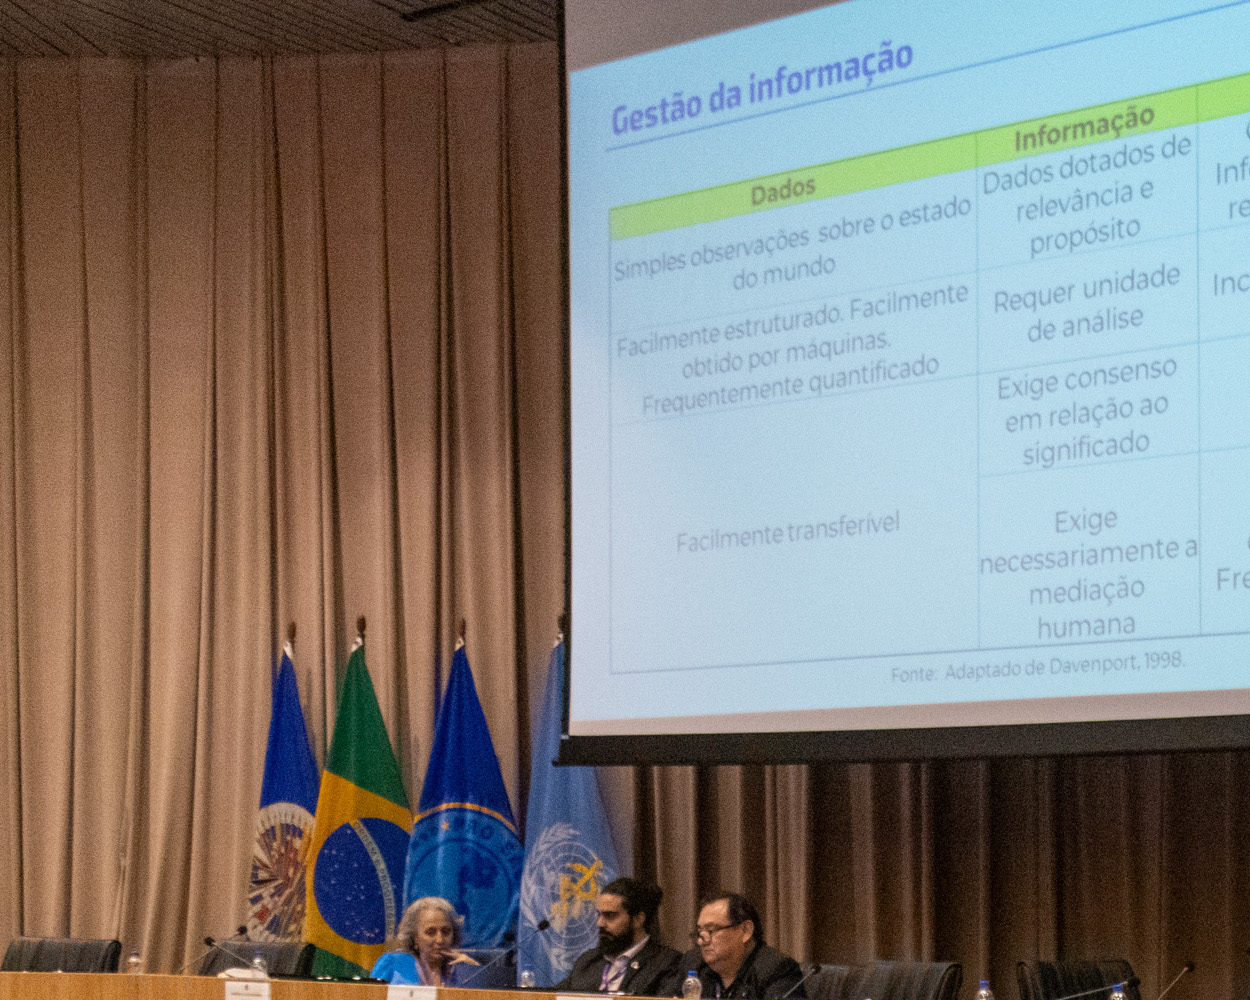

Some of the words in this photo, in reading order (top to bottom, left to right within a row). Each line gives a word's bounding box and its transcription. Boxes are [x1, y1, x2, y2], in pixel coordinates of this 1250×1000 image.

[611, 91, 701, 135] Gestão
[709, 82, 741, 113] da
[749, 40, 913, 104] informação
[1015, 104, 1155, 153] Informação
[983, 168, 1054, 195] Dados
[1059, 139, 1155, 178] dotados
[1162, 134, 1192, 158] de
[751, 176, 815, 206] Dados
[1016, 181, 1134, 222] relevância
[1140, 180, 1154, 200] e
[614, 248, 686, 282] Simples
[691, 229, 810, 267] observações
[818, 213, 874, 244] sobre
[880, 213, 894, 232] o
[899, 197, 971, 228] estado
[1030, 217, 1141, 259] propósito
[733, 267, 758, 291] do
[764, 255, 835, 283] mundo
[994, 281, 1075, 313] Requer
[1083, 262, 1181, 299] unidade
[618, 324, 720, 358] Facilmente
[724, 305, 844, 342] estruturado.
[850, 282, 968, 320] Facilmente
[1027, 316, 1056, 344] de
[1062, 305, 1144, 338] análise
[682, 352, 742, 380] obtido
[748, 350, 778, 372] por
[786, 327, 890, 367] máquinas.
[643, 377, 802, 417] Frequentemente
[809, 355, 939, 394] quantificado
[998, 366, 1059, 400] Exige
[1065, 356, 1177, 389] consenso
[1005, 410, 1041, 433] em
[1049, 394, 1134, 428] relação
[1140, 394, 1169, 418] ao
[1022, 429, 1150, 467] significado
[677, 526, 783, 553] Facilmente
[787, 510, 900, 541] transferível
[1055, 507, 1118, 534] Exige
[979, 538, 1180, 574] necessariamente
[1185, 540, 1198, 557] a
[1029, 575, 1146, 606] mediação
[1037, 613, 1136, 640] humana
[891, 666, 937, 684] Fonte:
[945, 661, 1021, 682] Adaptado
[1025, 659, 1044, 675] de
[1049, 652, 1139, 675] Davenport,
[1145, 650, 1185, 670] 1998.
